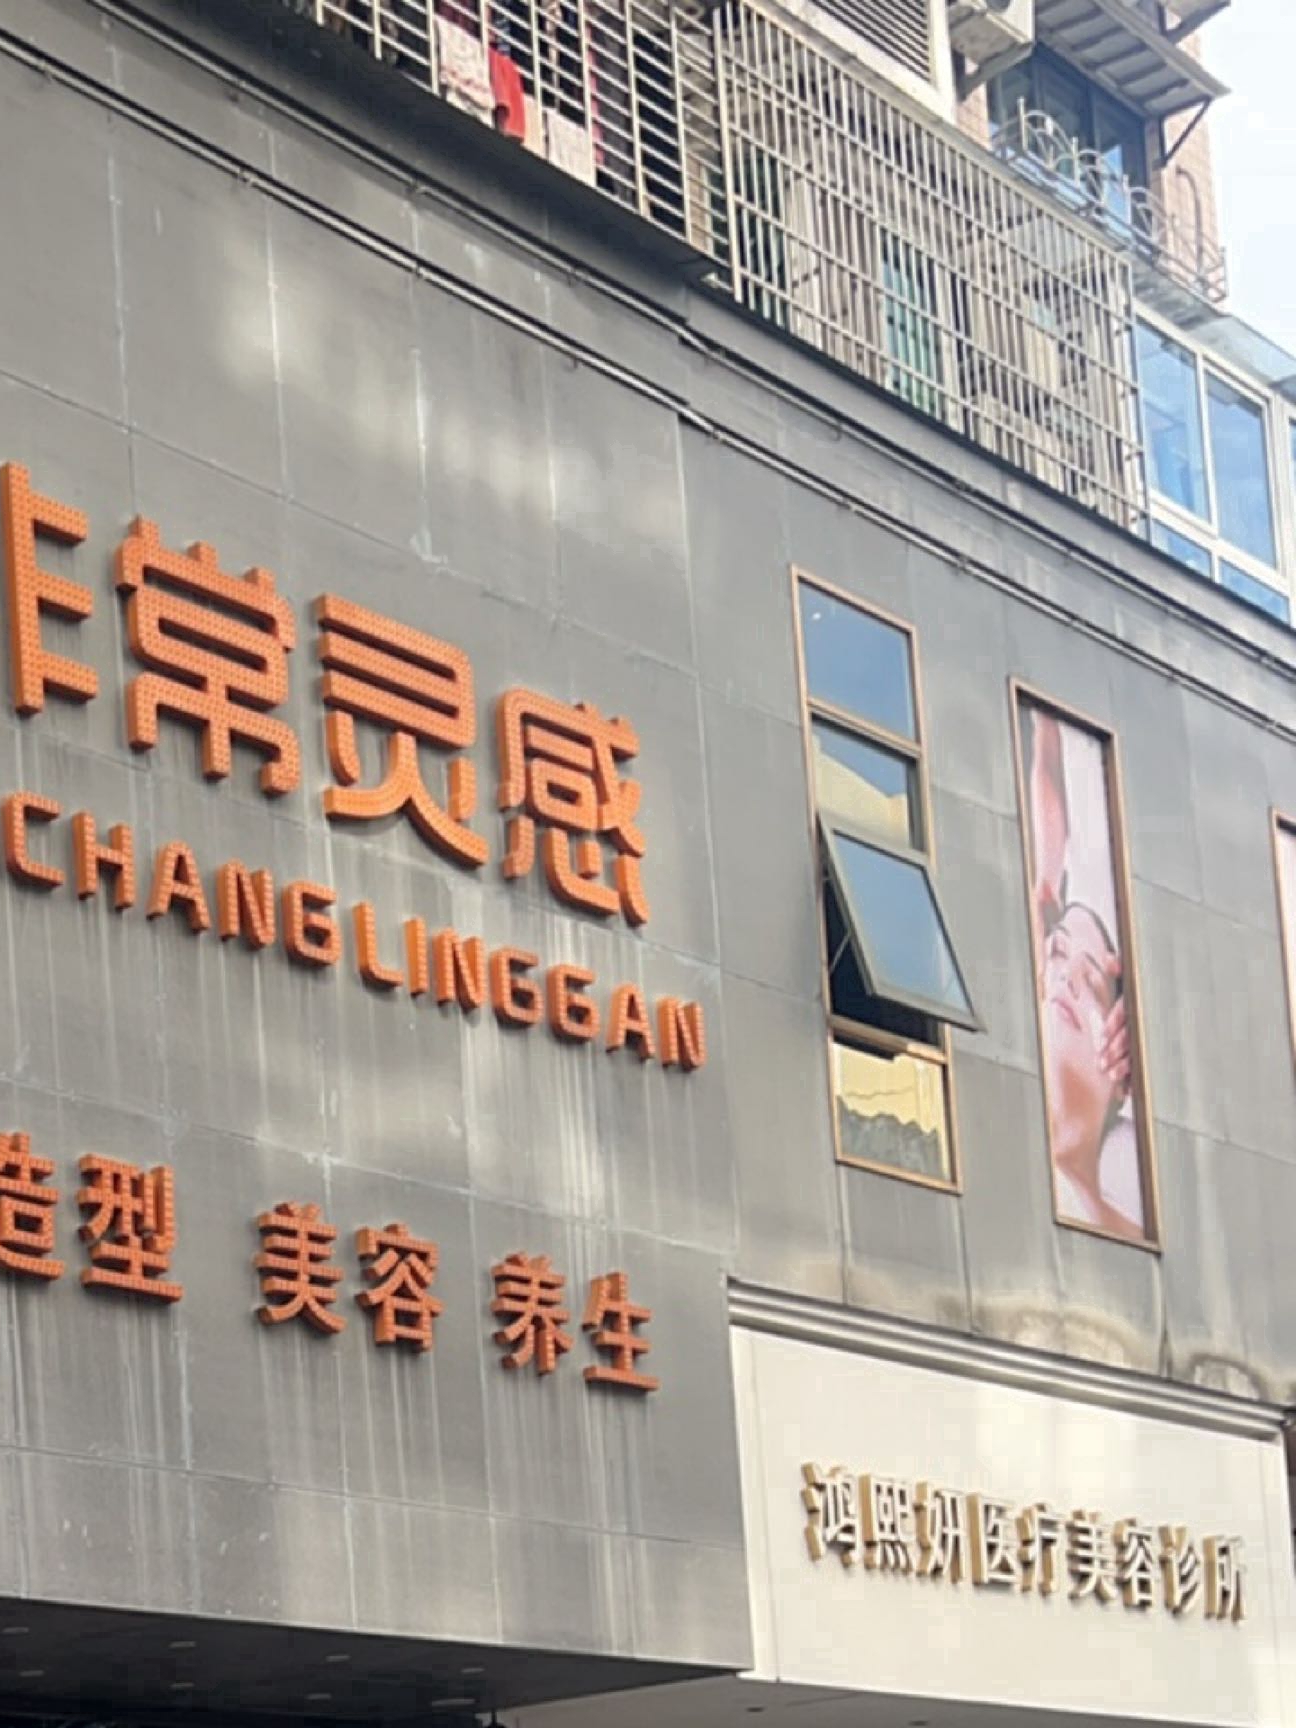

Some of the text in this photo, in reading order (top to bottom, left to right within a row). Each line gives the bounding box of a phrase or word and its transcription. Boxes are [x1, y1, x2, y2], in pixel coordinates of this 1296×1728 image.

[255, 1201, 444, 1354] 美容
[491, 1251, 661, 1394] 养生
[800, 1462, 1249, 1624] 鸿熙妍医疗美容诊所
